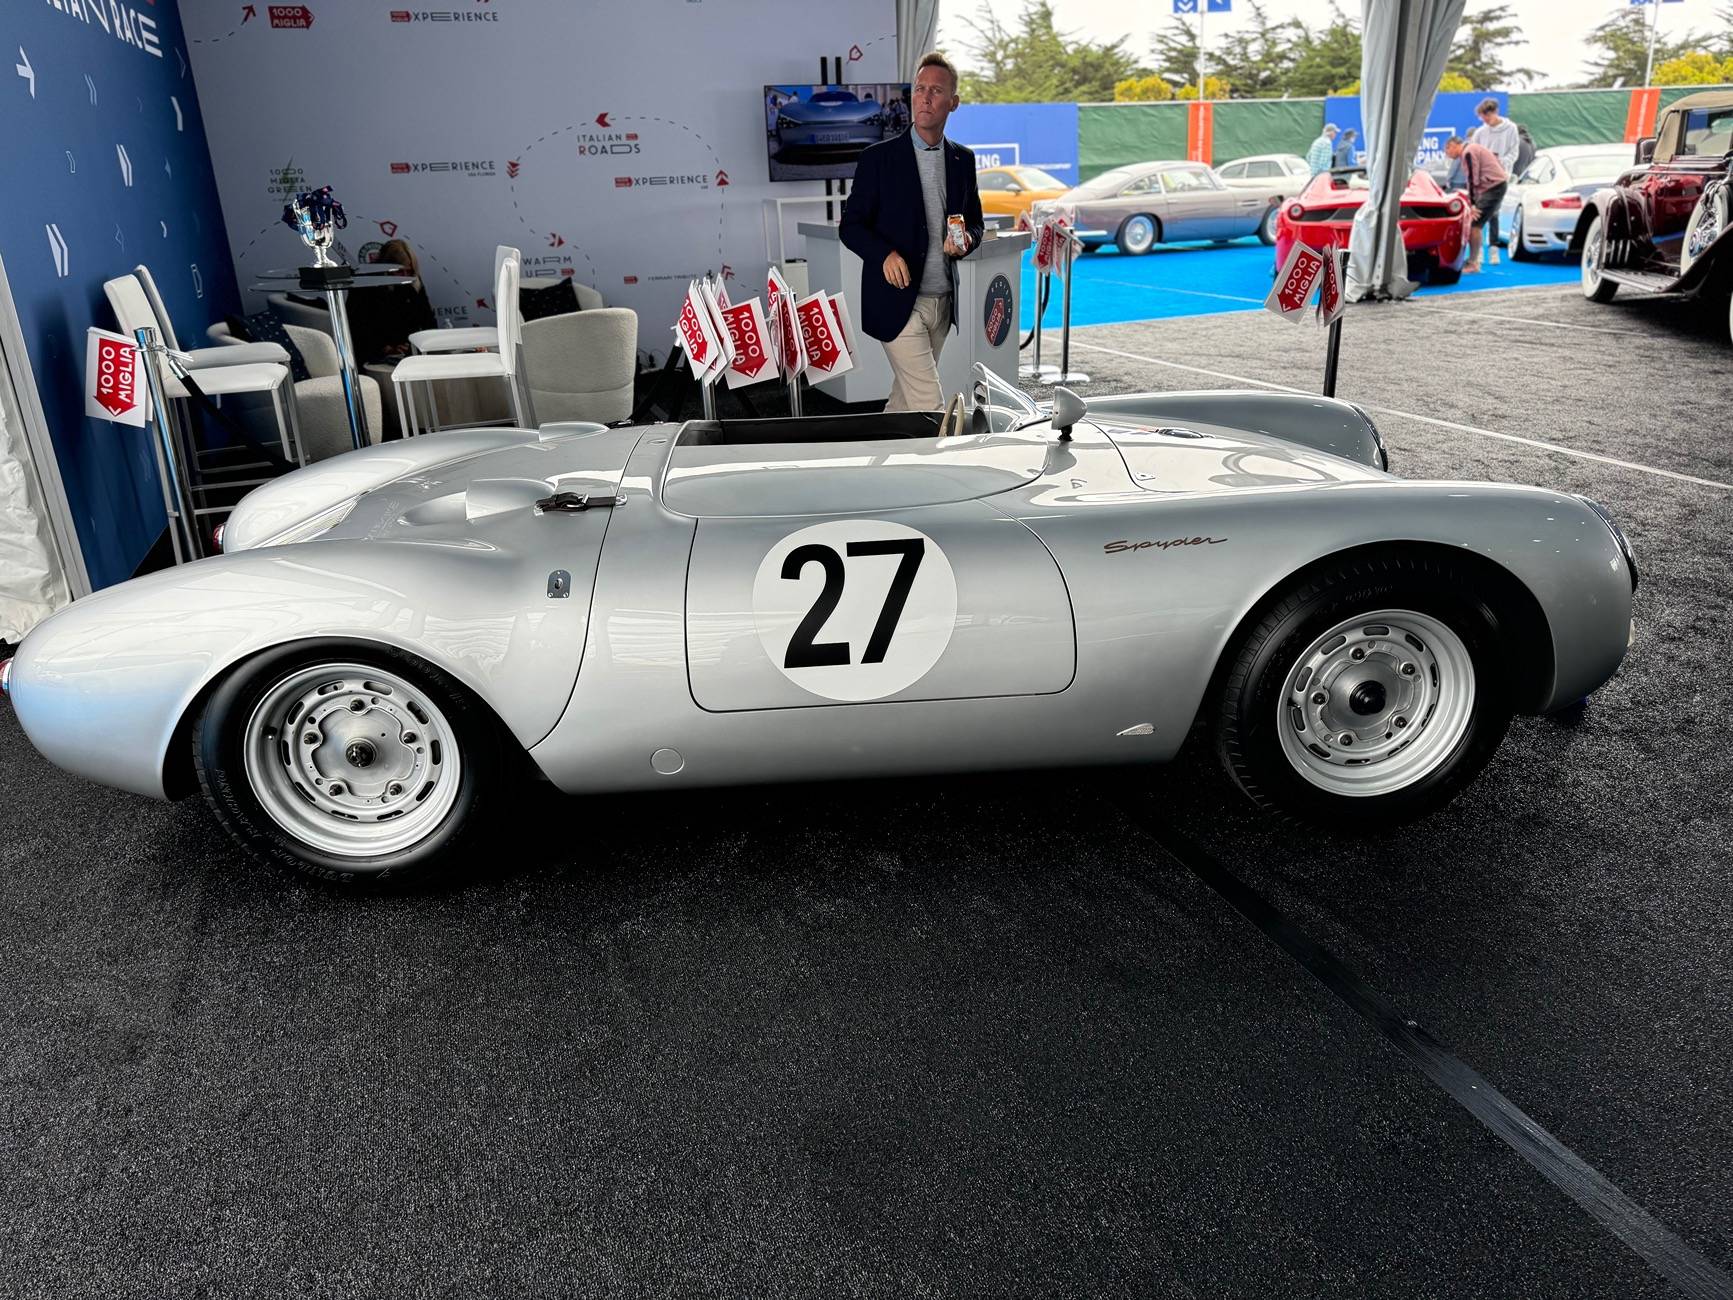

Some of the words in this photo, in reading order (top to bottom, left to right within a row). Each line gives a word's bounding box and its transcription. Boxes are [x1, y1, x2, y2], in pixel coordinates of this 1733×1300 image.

[110, 0, 163, 58] RACE
[272, 8, 302, 16] 1000
[272, 19, 307, 27] MIGLIA
[577, 134, 622, 143] ITALIAN
[578, 144, 641, 155] ROADS
[522, 255, 573, 265] WARM
[525, 268, 557, 278] UP
[1284, 257, 1308, 295] 1000
[1293, 260, 1321, 304] MIGLIA
[680, 313, 698, 355] IGLIA
[684, 299, 704, 343] 1000
[738, 311, 761, 358] 1000
[797, 310, 821, 361] MIGLIA
[809, 307, 833, 352] 1000
[100, 345, 116, 395] 1000
[117, 347, 133, 403] MIGLIA
[1103, 536, 1229, 555] Spyder
[780, 537, 926, 669] 27
